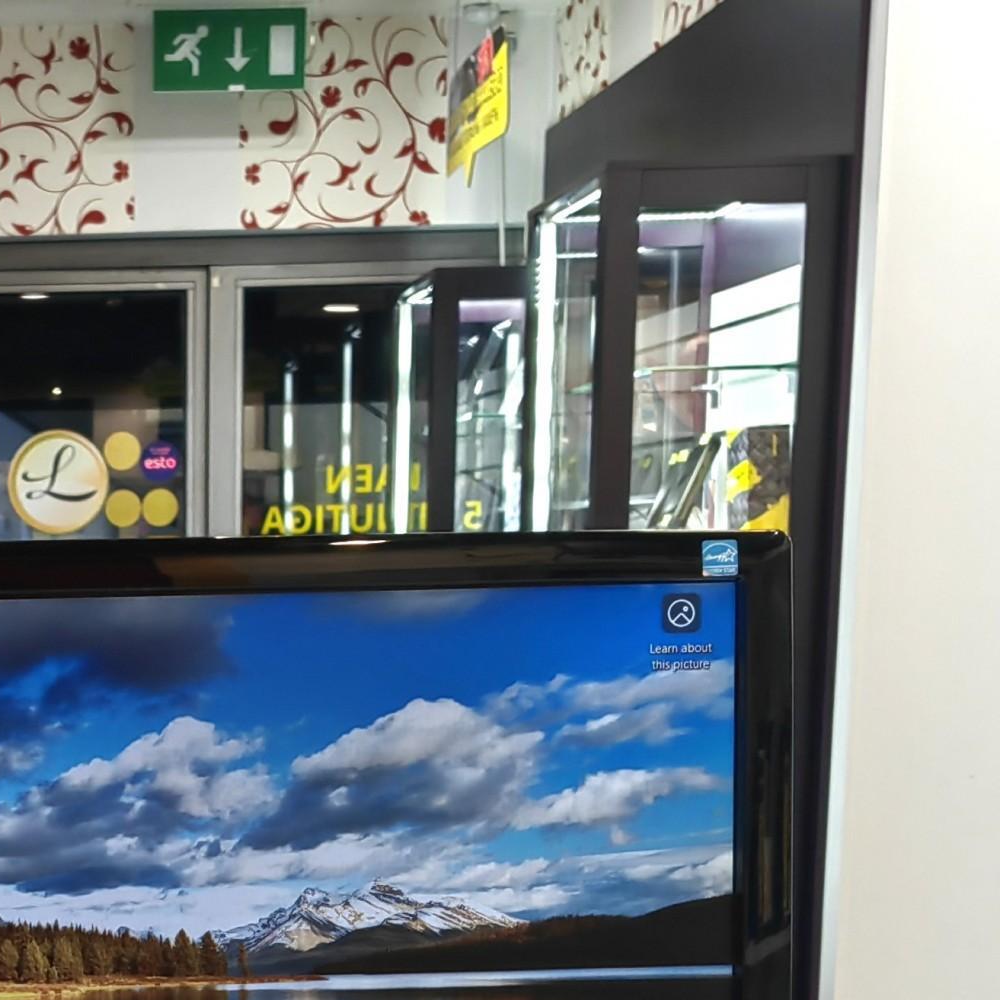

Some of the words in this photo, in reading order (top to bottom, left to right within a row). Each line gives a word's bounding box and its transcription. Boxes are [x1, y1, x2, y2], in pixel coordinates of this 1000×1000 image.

[649, 643, 678, 654] Learn
[680, 643, 712, 653] about
[652, 660, 671, 670] this
[673, 659, 711, 672] picture
